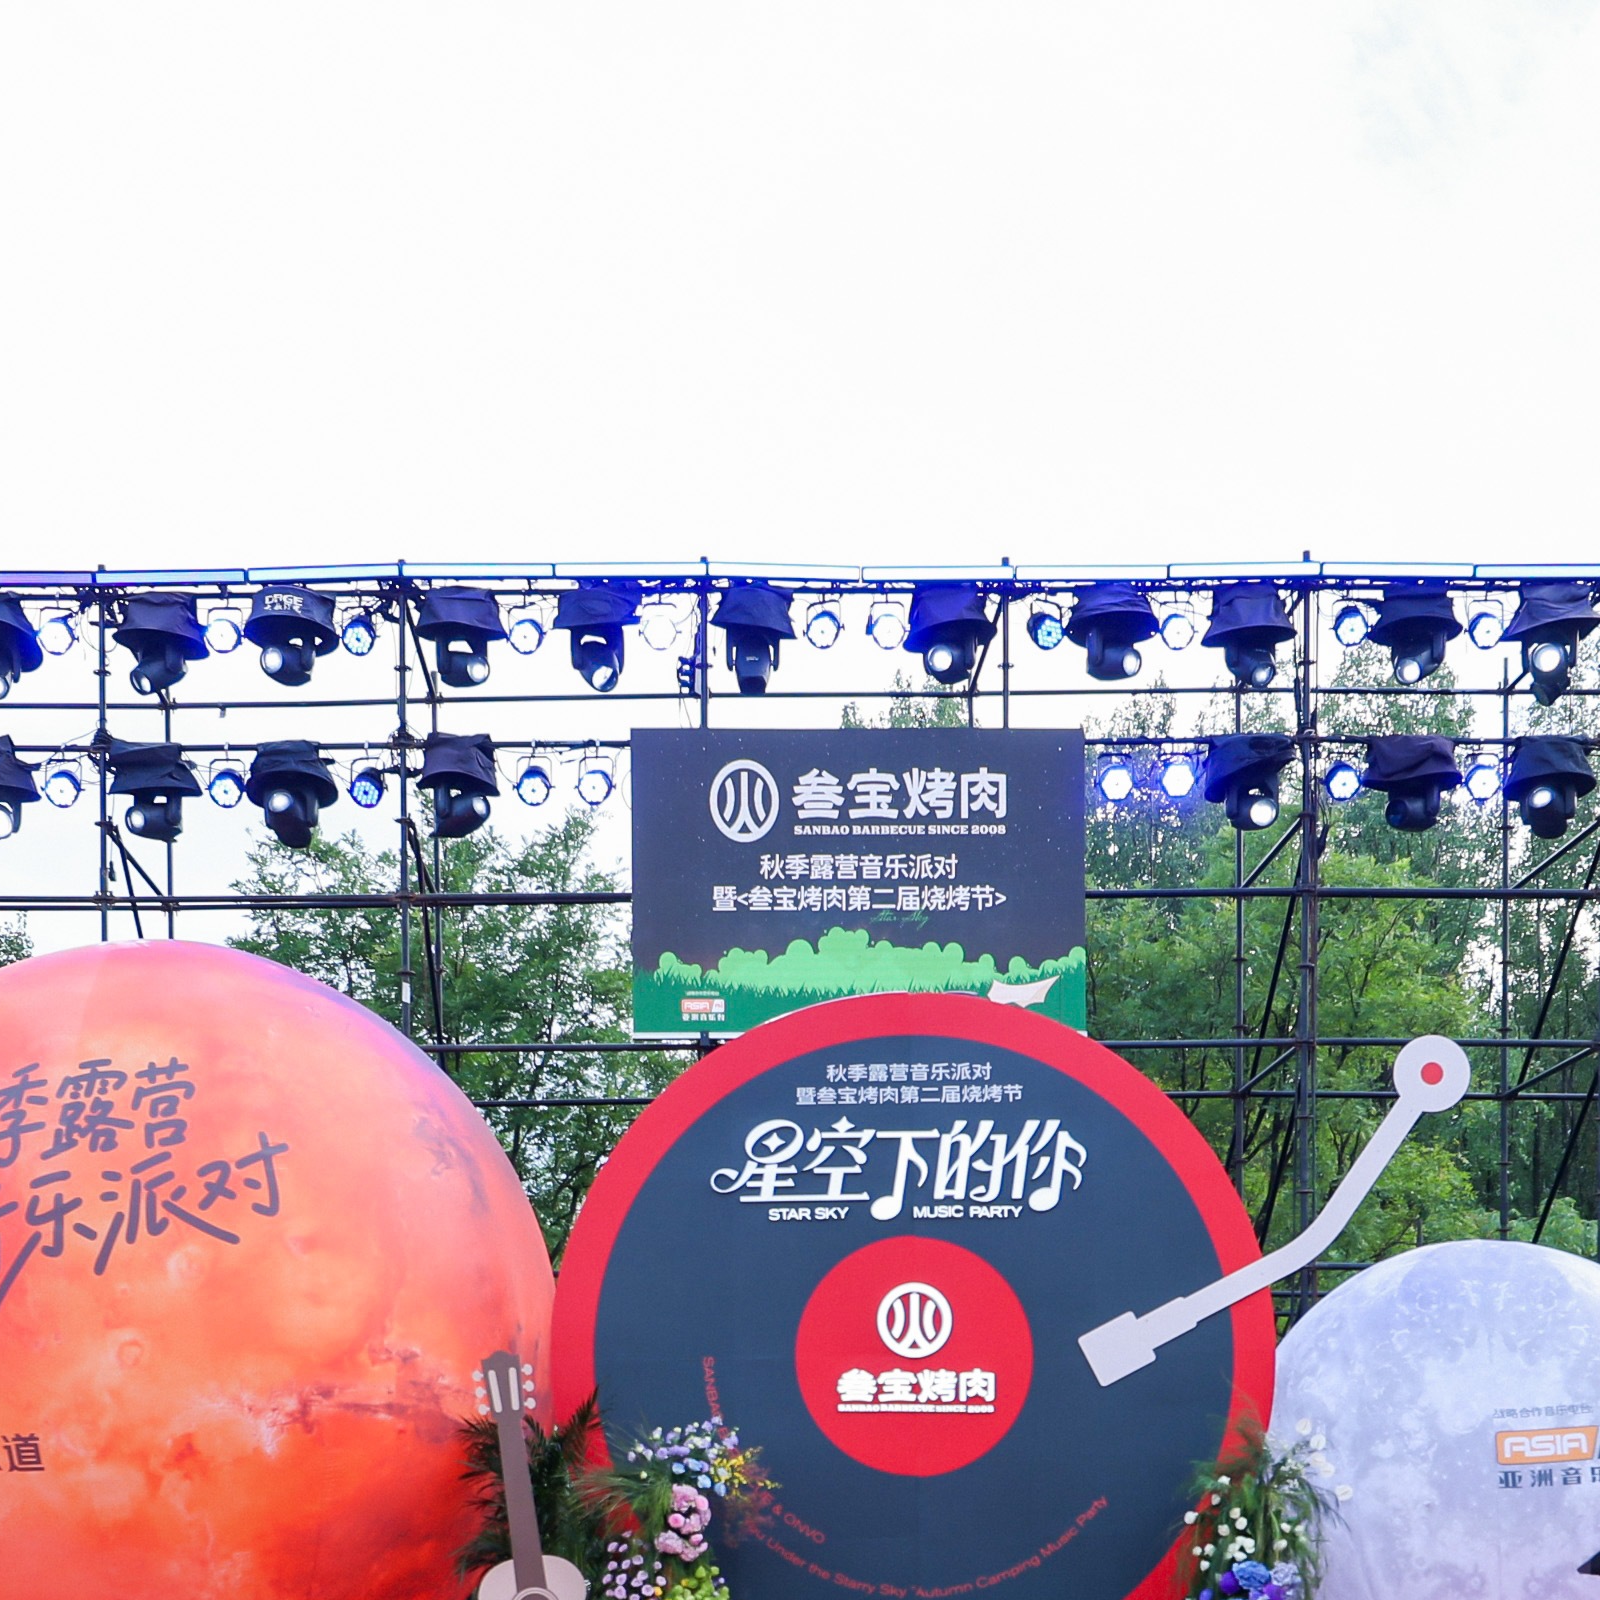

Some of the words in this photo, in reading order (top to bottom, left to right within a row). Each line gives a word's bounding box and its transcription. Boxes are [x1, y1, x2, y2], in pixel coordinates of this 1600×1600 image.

[791, 767, 1007, 820] 叁宝烤肉
[793, 825, 850, 836] SANBAO
[851, 825, 926, 836] BARBECUE
[927, 824, 969, 835] SINCE
[970, 824, 1007, 835] 2008
[759, 853, 958, 880] 秋季露营音乐派对
[712, 884, 1007, 912] 暨<叁宝烤肉第二届烧烤节>
[825, 1062, 993, 1084] 秋季露营音乐派对
[795, 1083, 1024, 1107] 暨叁宝烤肉第二届烧烤节
[709, 1116, 1088, 1221] 星空下的你
[767, 1207, 811, 1222] STAR
[813, 1206, 850, 1222] SKY
[912, 1205, 964, 1220] MUSIC
[968, 1204, 1024, 1220] PARTY
[835, 1368, 997, 1404] 叁宝烤肉
[1503, 1432, 1589, 1458] ASIA
[783, 1511, 827, 1545] ONVO
[766, 1536, 807, 1568] Under
[808, 1562, 832, 1582] the
[832, 1572, 877, 1596] Starry
[879, 1582, 908, 1600] Sky
[975, 1554, 1042, 1590] Camping
[1039, 1526, 1080, 1560] Music
[1075, 1495, 1110, 1529] Party
